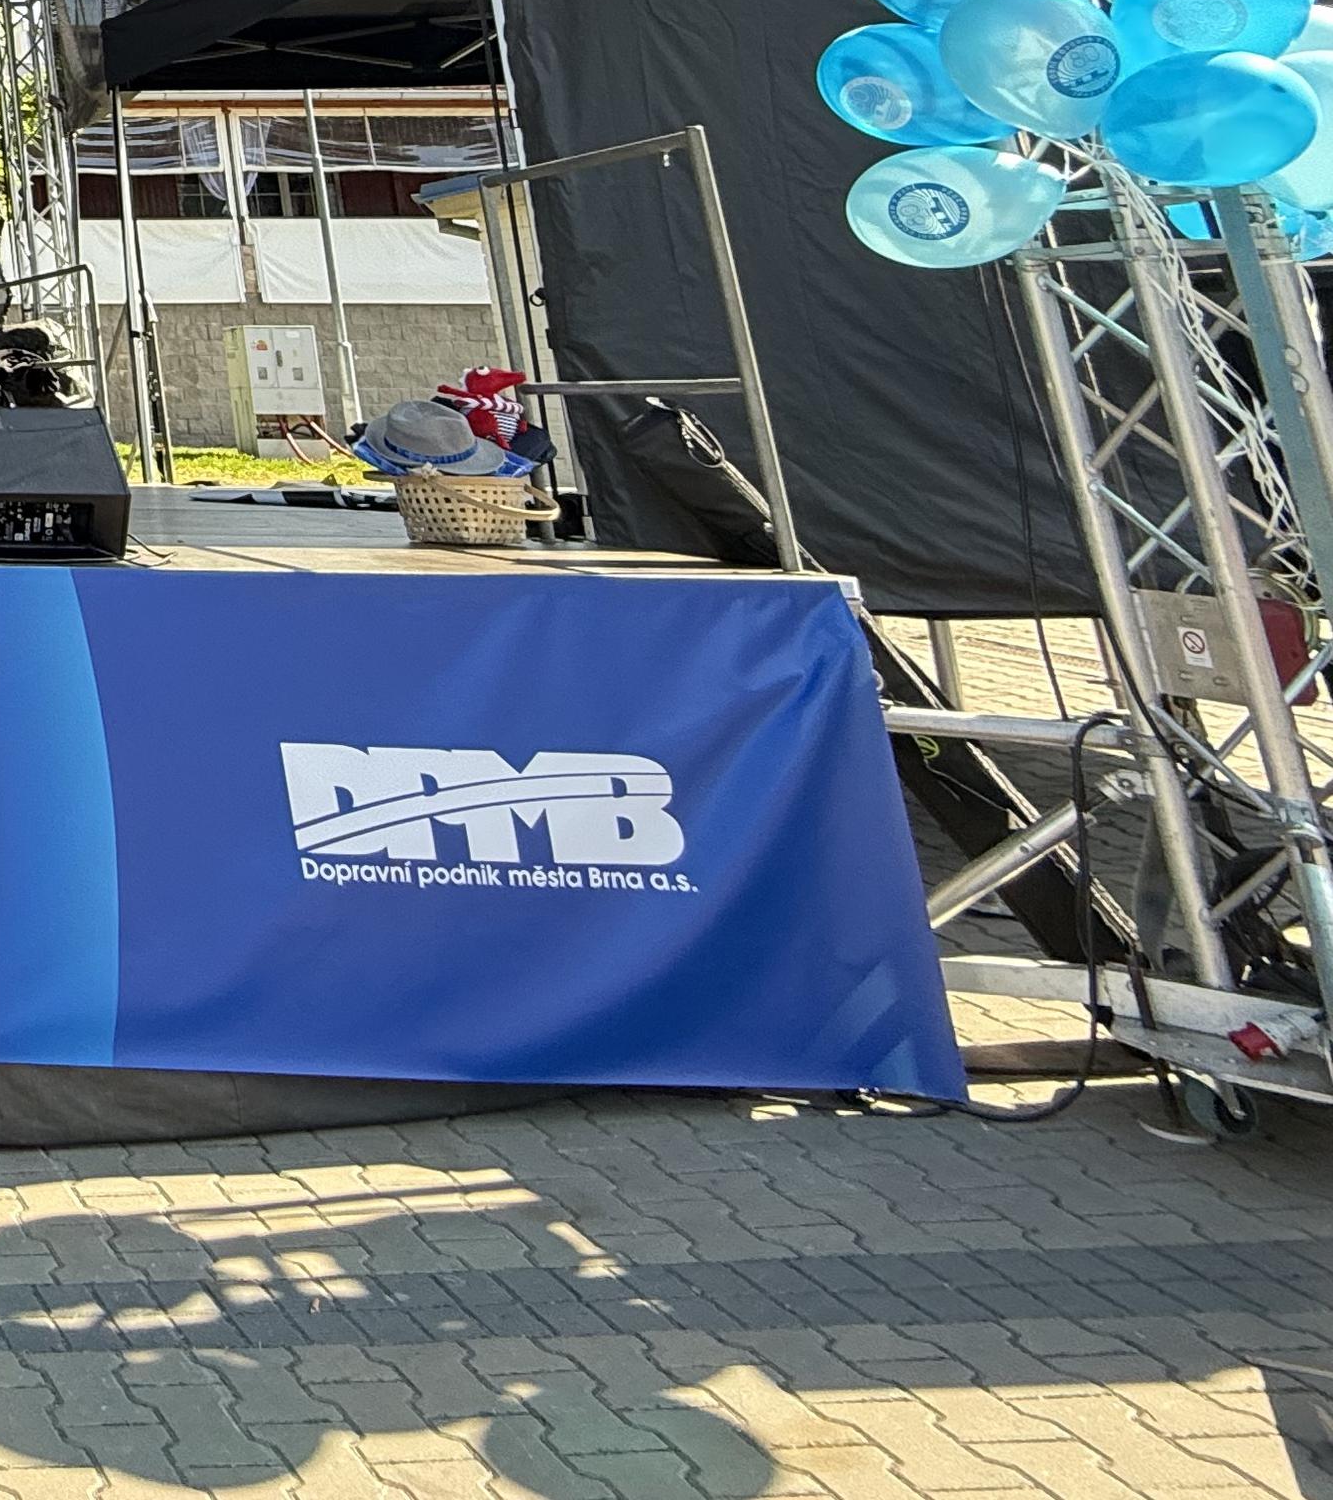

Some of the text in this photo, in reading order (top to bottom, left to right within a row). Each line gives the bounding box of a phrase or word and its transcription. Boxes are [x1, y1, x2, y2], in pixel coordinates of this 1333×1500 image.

[279, 741, 686, 866] DPMB
[300, 857, 699, 893] Dopravní podnik města Brna a.s.
